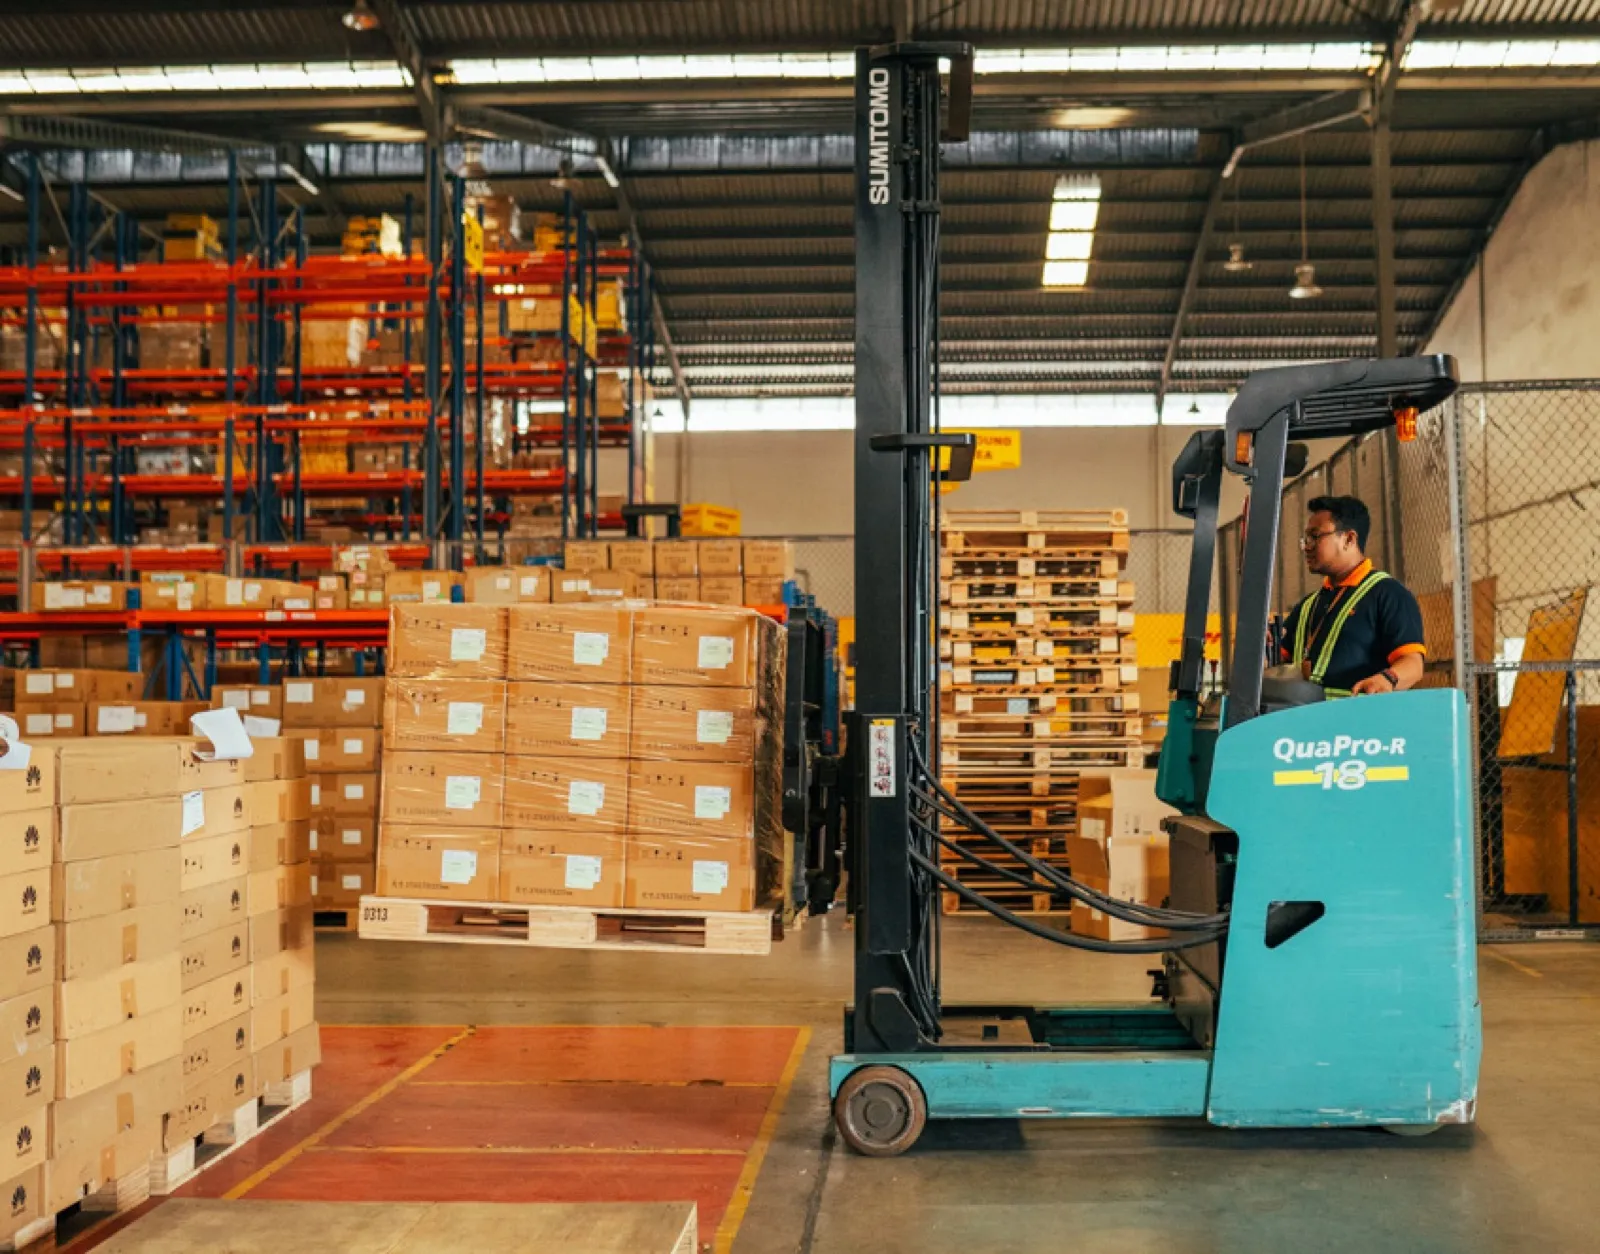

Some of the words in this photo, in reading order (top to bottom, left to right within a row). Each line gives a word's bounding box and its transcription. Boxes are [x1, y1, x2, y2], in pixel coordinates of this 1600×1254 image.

[869, 67, 890, 205] SUMITOMO
[1273, 735, 1406, 763] QuaPro-R
[1313, 759, 1367, 791] 18
